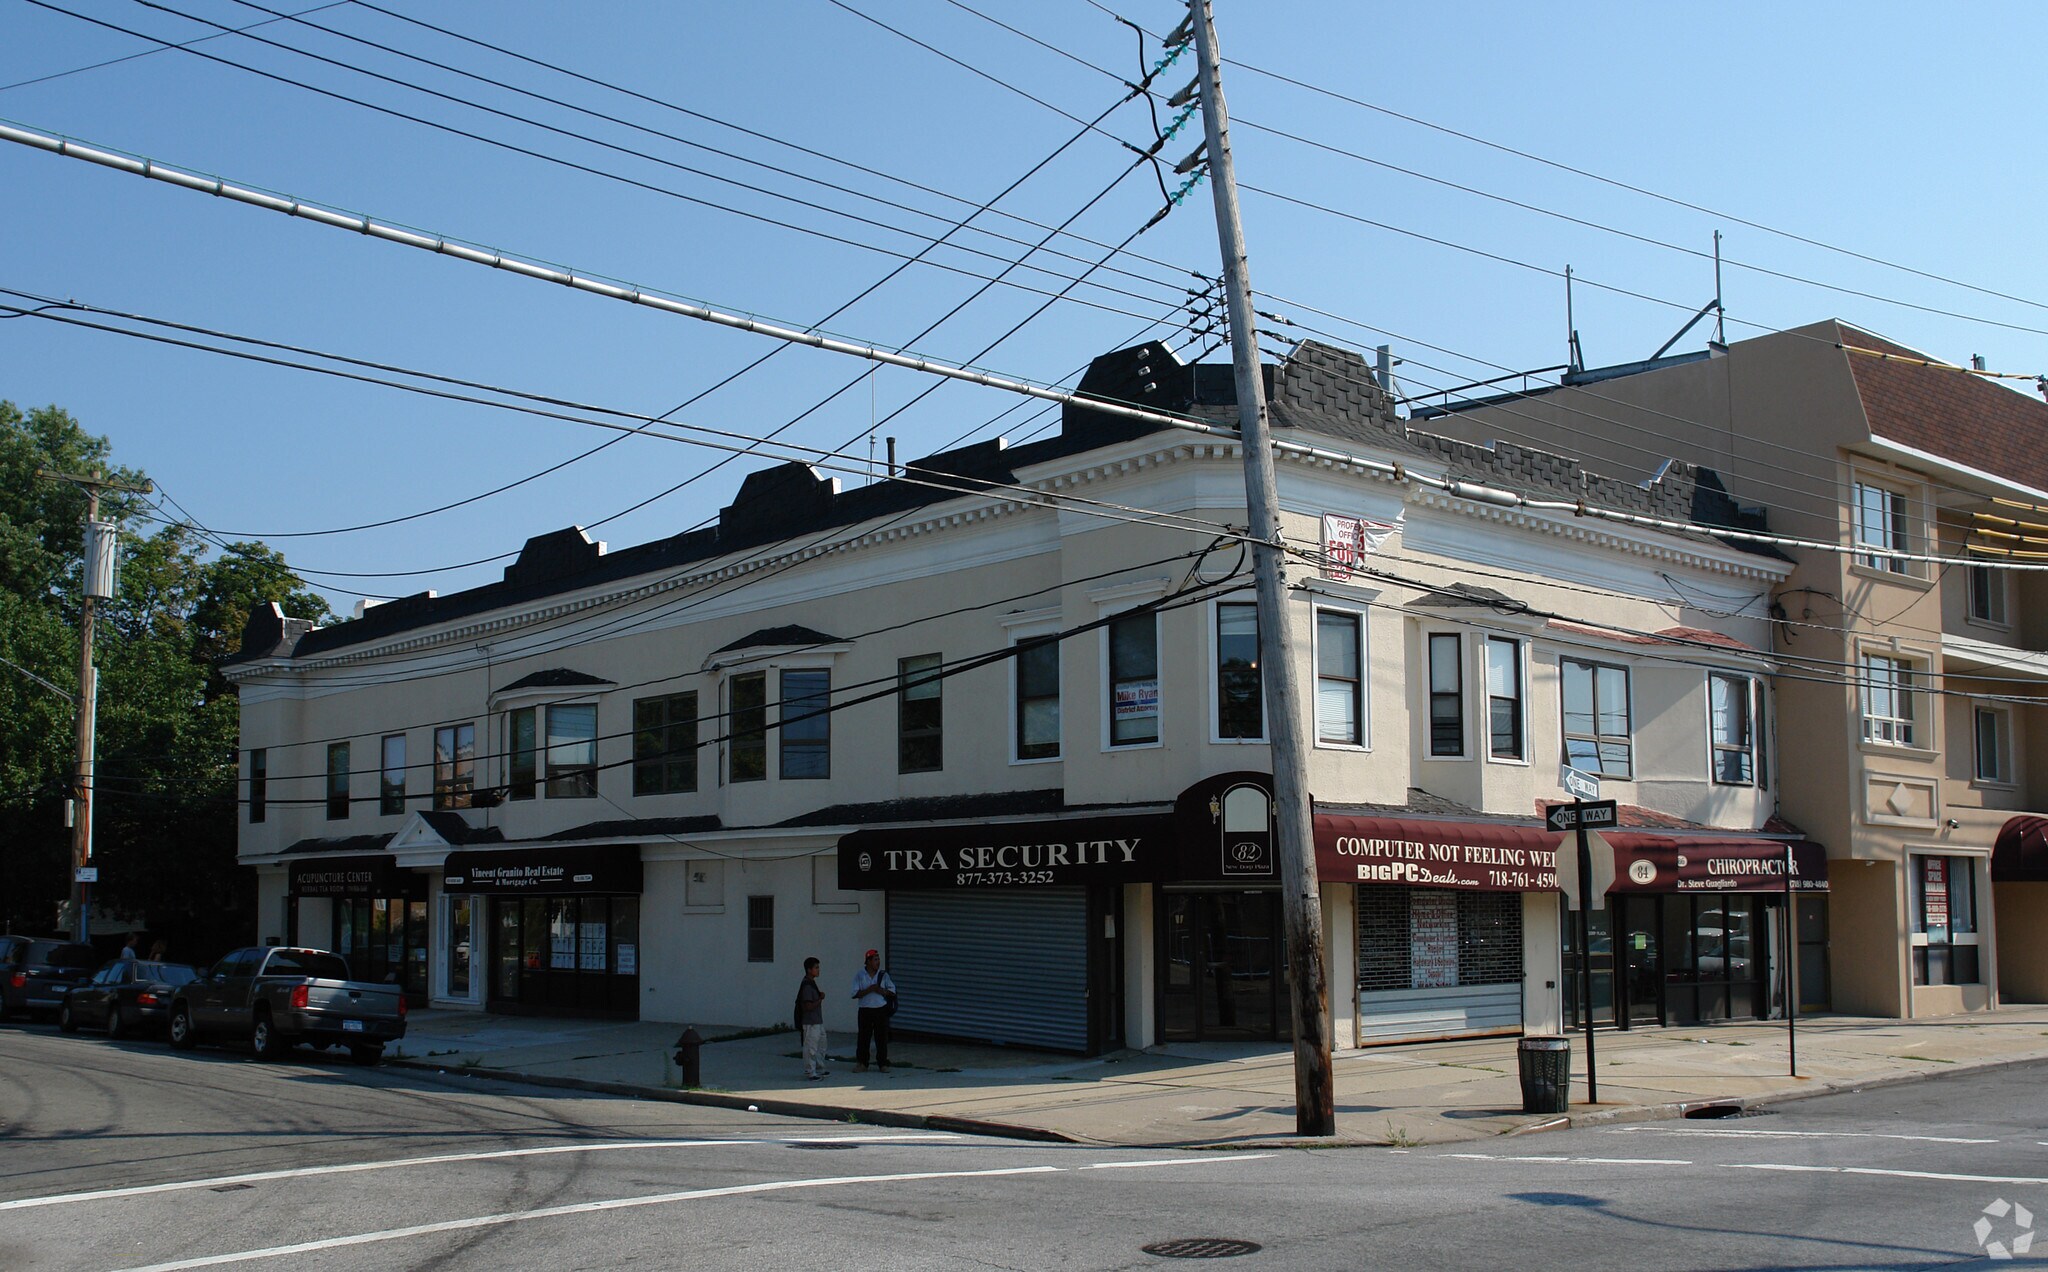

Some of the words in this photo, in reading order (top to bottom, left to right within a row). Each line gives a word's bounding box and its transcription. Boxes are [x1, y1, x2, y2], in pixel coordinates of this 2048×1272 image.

[1329, 540, 1354, 565] FOR
[1117, 691, 1136, 701] Mike
[1117, 705, 1136, 714] District
[1569, 775, 1580, 790] ONE
[1584, 782, 1595, 796] WAY
[1556, 812, 1576, 823] ONE
[1585, 809, 1607, 821] WAY
[884, 849, 950, 871] TRA
[958, 837, 1142, 870] SECURITY
[1237, 844, 1257, 860] 82
[1336, 836, 1425, 860] COMPUTER
[1428, 843, 1460, 863] NOT
[1464, 846, 1525, 868] FEELING
[297, 872, 345, 884] ACUPUNCTURE
[346, 871, 373, 883] CENTER
[471, 867, 497, 878] Vincent
[497, 866, 524, 878] Granito
[524, 866, 541, 877] Real
[541, 865, 564, 877] Estate
[956, 870, 1055, 886] 877-373-3252
[1637, 865, 1648, 879] 84
[501, 878, 528, 887] Mortgage
[528, 878, 539, 886] Co.
[1677, 879, 1687, 888] Dr.
[1688, 879, 1705, 888] Steve
